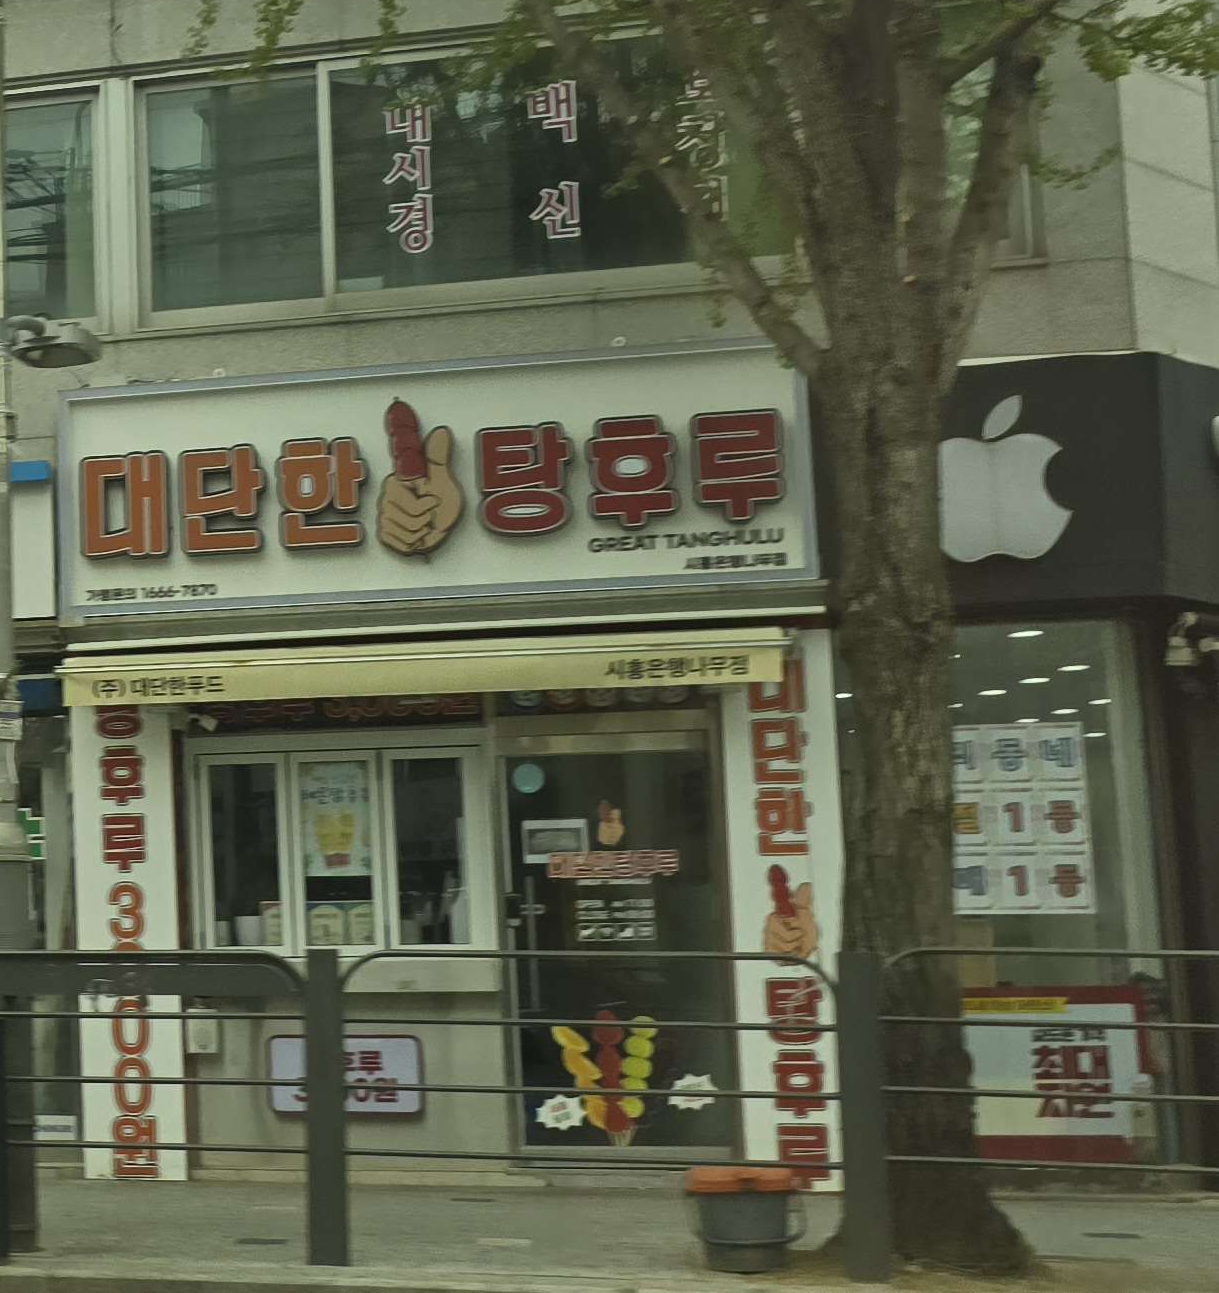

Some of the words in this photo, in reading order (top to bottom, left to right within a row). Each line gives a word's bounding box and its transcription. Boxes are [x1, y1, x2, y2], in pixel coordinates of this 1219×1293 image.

[383, 97, 434, 254] 내시경
[527, 80, 581, 240] 백신
[79, 435, 367, 562] 대단한
[473, 407, 790, 539] 탕후루
[588, 534, 659, 553] GREAT
[663, 527, 785, 549] TANGHULU
[91, 678, 127, 699] (주)
[107, 880, 160, 1179] 300원
